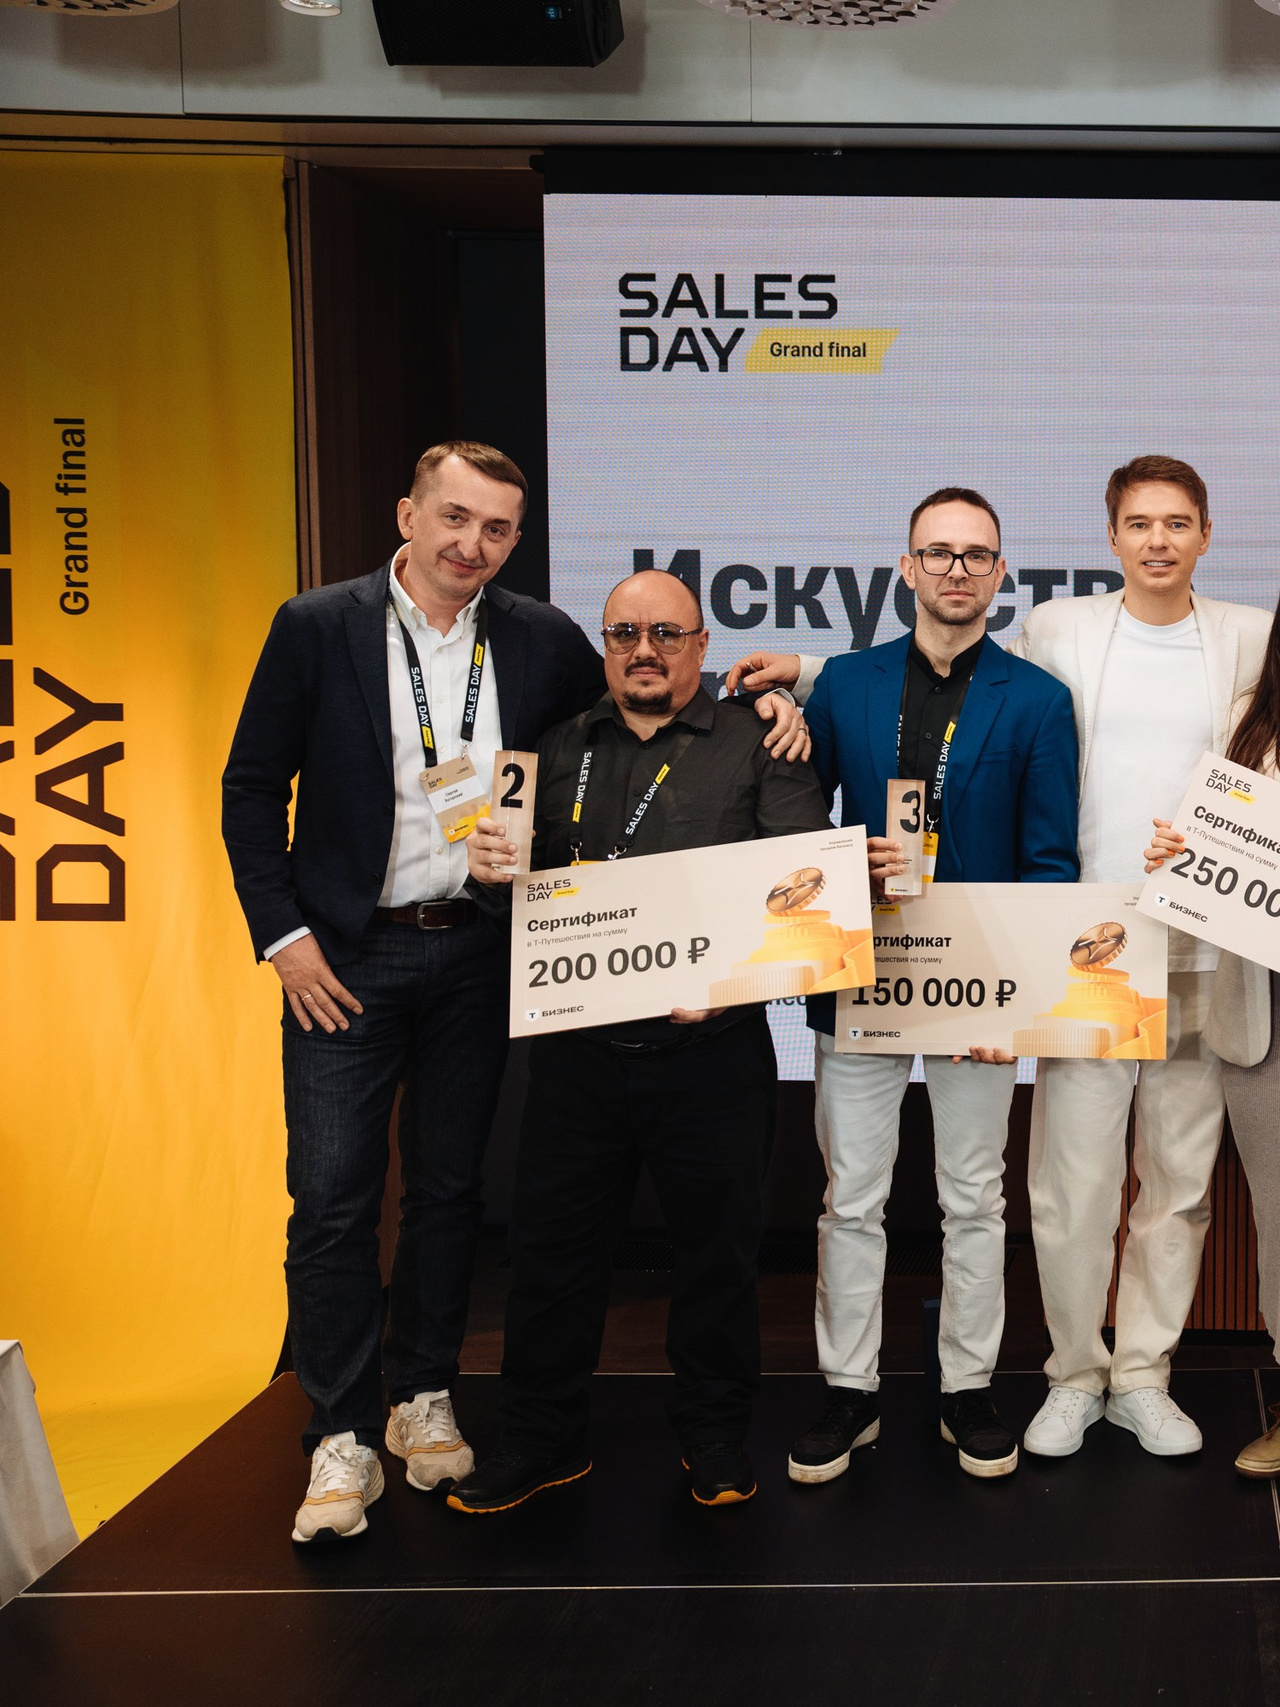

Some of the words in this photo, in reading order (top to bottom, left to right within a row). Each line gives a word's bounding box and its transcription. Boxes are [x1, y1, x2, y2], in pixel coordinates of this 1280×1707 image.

[618, 272, 838, 319] SALES
[619, 327, 745, 372] DAY
[769, 341, 824, 358] Grand
[828, 341, 867, 358] final
[53, 418, 87, 496] final
[59, 507, 90, 615] Grand
[411, 666, 426, 703] SALES
[470, 664, 481, 686] DAY
[418, 705, 430, 726] DAY
[465, 688, 478, 723] SALES
[579, 751, 592, 783] SALES
[939, 741, 951, 762] DAY
[33, 667, 126, 921] DAY
[501, 763, 525, 809] 2
[575, 784, 586, 803] DAY
[933, 764, 947, 800] SALES
[1205, 778, 1232, 794] DAY
[1210, 769, 1252, 793] SALES
[625, 801, 648, 836] SALES
[643, 781, 659, 802] DAY
[900, 789, 921, 834] 3
[1193, 826, 1245, 855] Т-Путешествия
[1245, 851, 1255, 860] на
[1255, 856, 1279, 871] сумму
[527, 879, 571, 893] SALES
[1170, 847, 1239, 896] 250
[527, 890, 553, 902] DAY
[527, 907, 638, 932] Сертификат
[1169, 901, 1208, 923] БИЗНЕС
[534, 932, 591, 946] Т-Путешествия
[603, 928, 628, 937] сумму
[873, 934, 952, 950] ртификат
[528, 952, 597, 988] 200
[607, 941, 677, 976] 000
[852, 977, 914, 1006] 150
[922, 977, 986, 1008] 000
[541, 1005, 584, 1017] БИЗНЕС
[863, 1030, 901, 1038] БИЗНЕС
